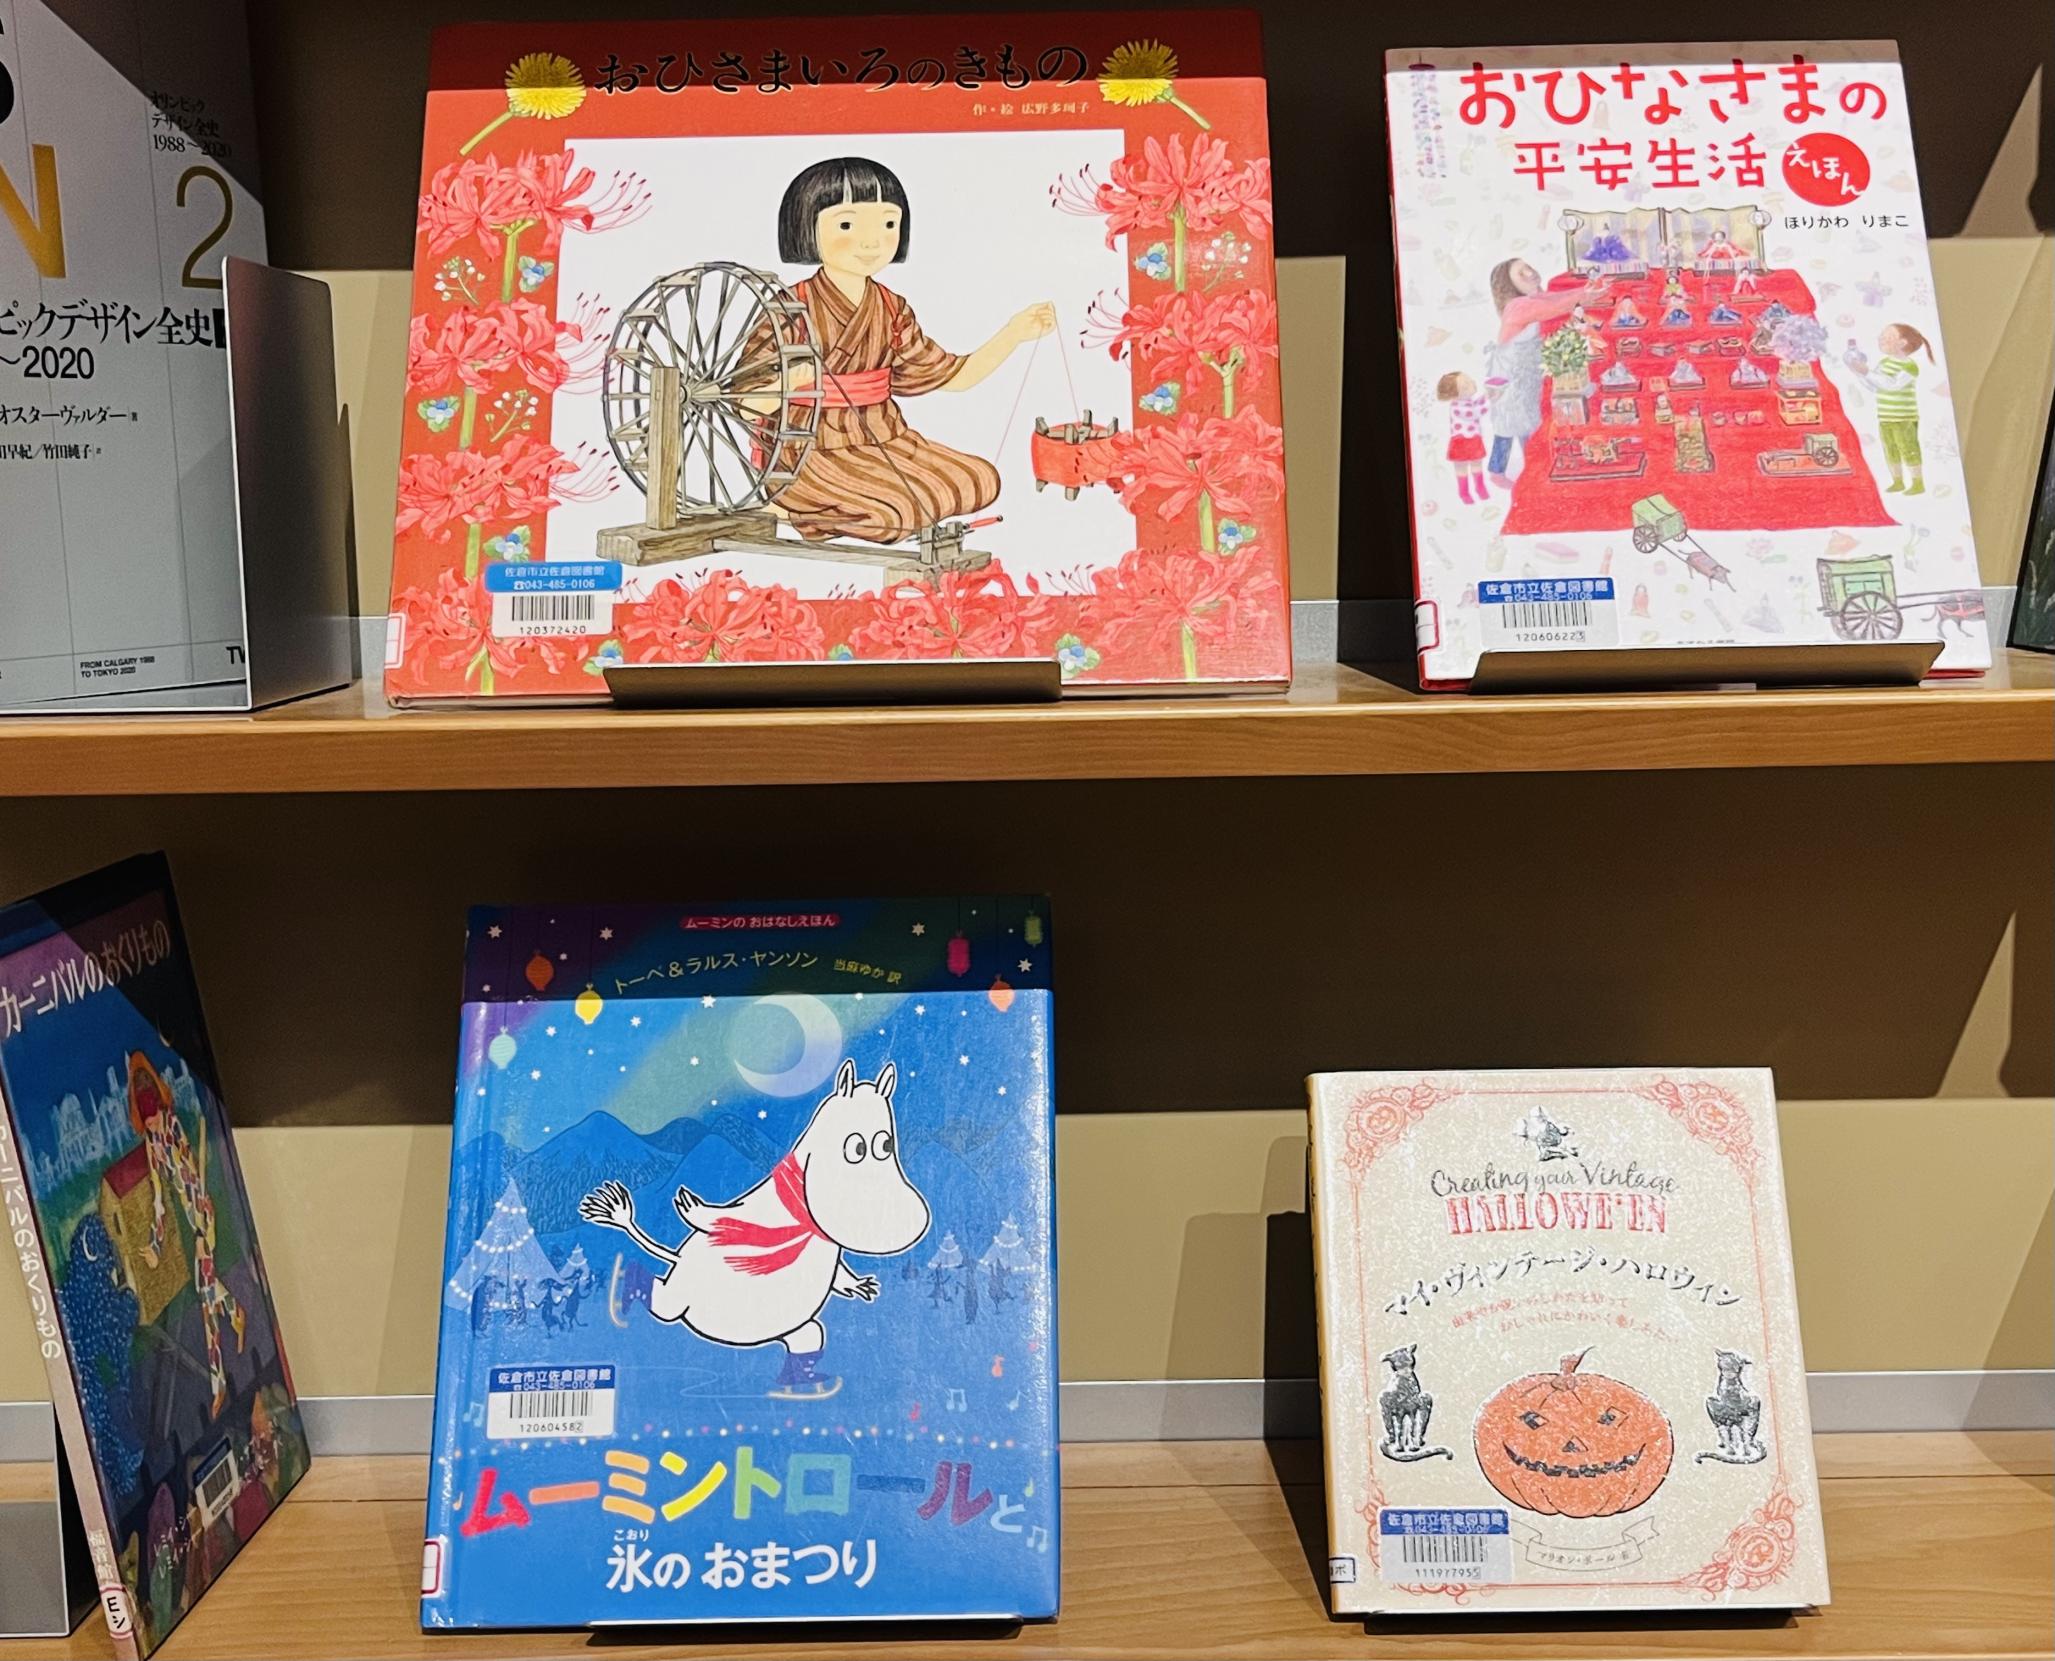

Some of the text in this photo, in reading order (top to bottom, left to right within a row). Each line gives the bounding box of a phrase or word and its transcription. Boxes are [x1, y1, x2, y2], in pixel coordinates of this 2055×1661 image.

[594, 43, 1088, 95] おひさまいろのきもの
[1459, 54, 1887, 128] おひなさまの
[1513, 132, 1767, 190] 平安生活
[1786, 141, 1865, 196] えほん
[1784, 215, 1909, 229] ほりかわ りまこ
[525, 579, 595, 590] 043-485-0106
[520, 625, 587, 636] 120372420
[1516, 631, 1586, 643] 120606223
[80, 660, 102, 669] FROM
[103, 657, 138, 668] CALGARY
[81, 670, 92, 678] TO
[93, 667, 119, 677] TOKYO
[685, 914, 836, 929] ムーミンの おはなしえほん
[1430, 1162, 1529, 1198] Creating
[1579, 1160, 1678, 1194] Vintage
[520, 1421, 583, 1433] 120604582
[613, 1529, 649, 1541] こおり
[606, 1539, 877, 1592] 氷の おまつり
[106, 1596, 120, 1612] E
[112, 1615, 125, 1629] シ
